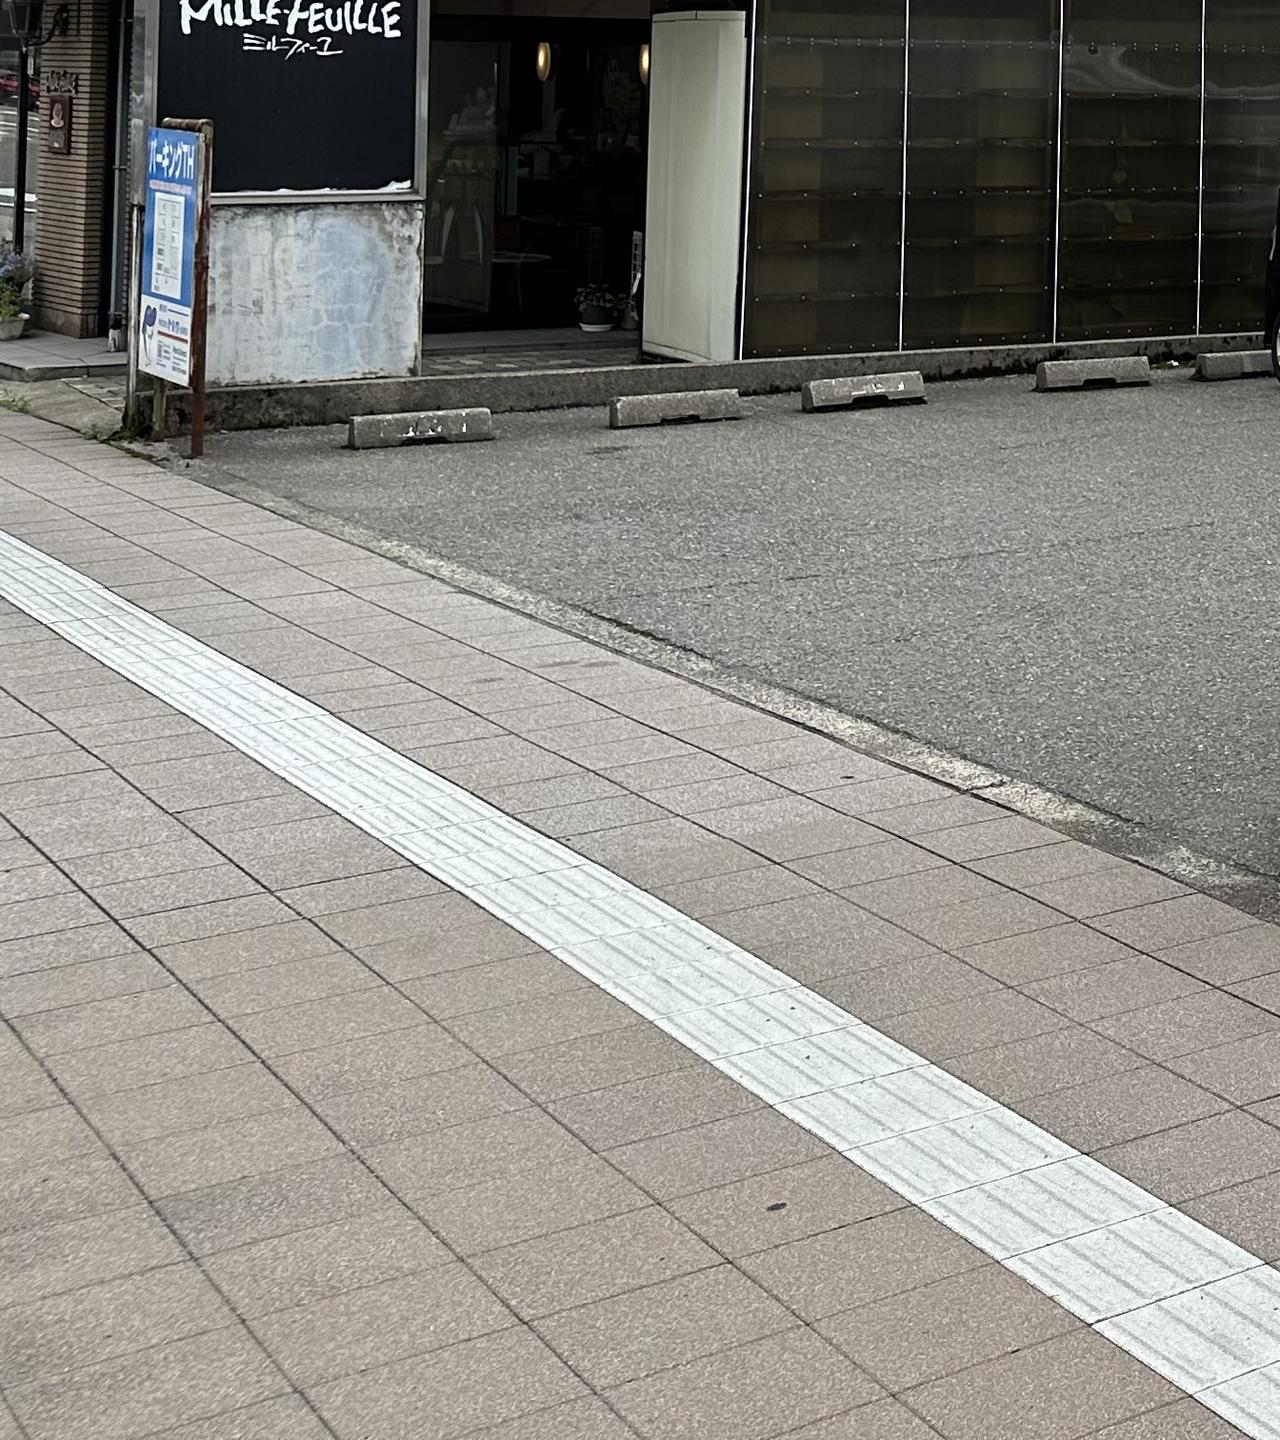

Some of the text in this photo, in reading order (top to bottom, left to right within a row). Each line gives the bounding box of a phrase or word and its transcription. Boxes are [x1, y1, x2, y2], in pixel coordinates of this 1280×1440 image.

[243, 33, 343, 60] ミルフィーユ
